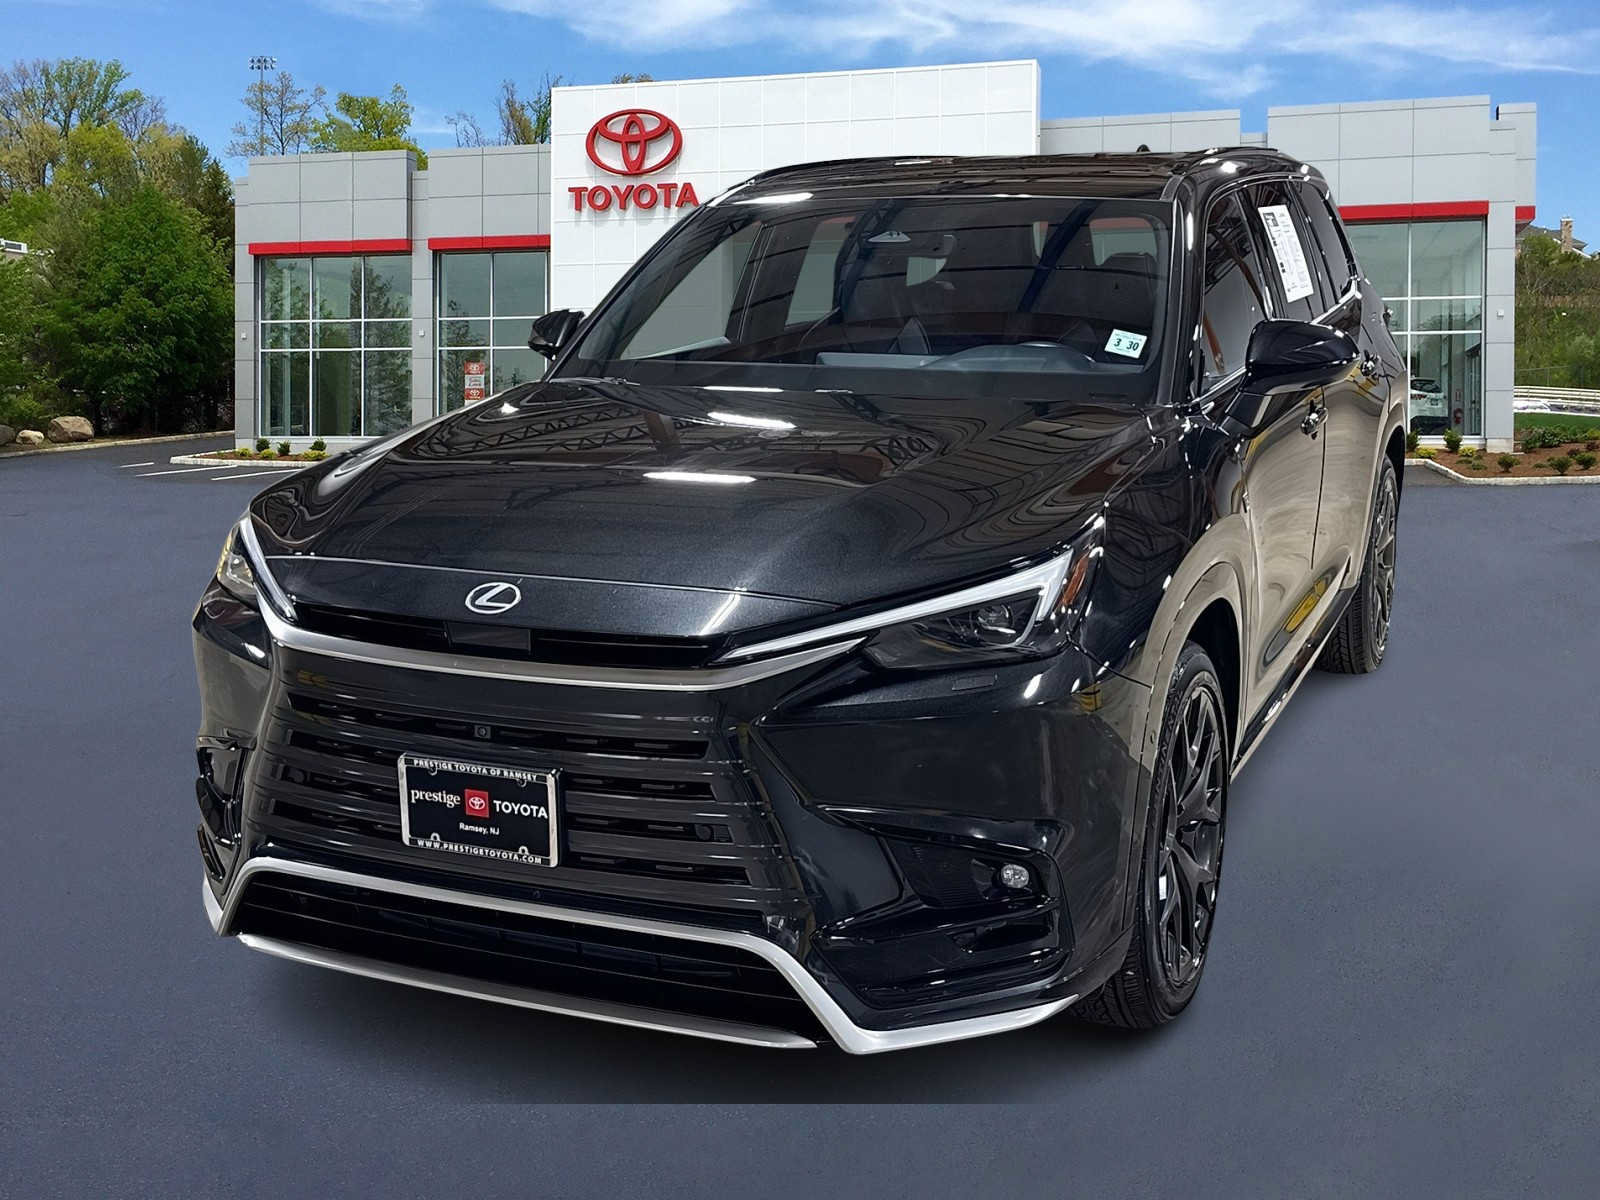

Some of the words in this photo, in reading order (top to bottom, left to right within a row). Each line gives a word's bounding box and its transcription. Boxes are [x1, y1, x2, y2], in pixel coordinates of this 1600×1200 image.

[568, 182, 700, 212] TOYOTA
[1113, 338, 1122, 347] 3
[1126, 340, 1140, 351] 30
[413, 759, 453, 770] PRESTIGE
[454, 764, 488, 775] TOYOTA
[503, 769, 537, 782] RAMSEY
[410, 789, 461, 808] prestige
[493, 800, 548, 819] TOYOTA
[459, 822, 489, 835] Ramsey,
[489, 826, 500, 836] NJ
[417, 839, 542, 864] WWW.PRESTIGETOYOTA.COM
